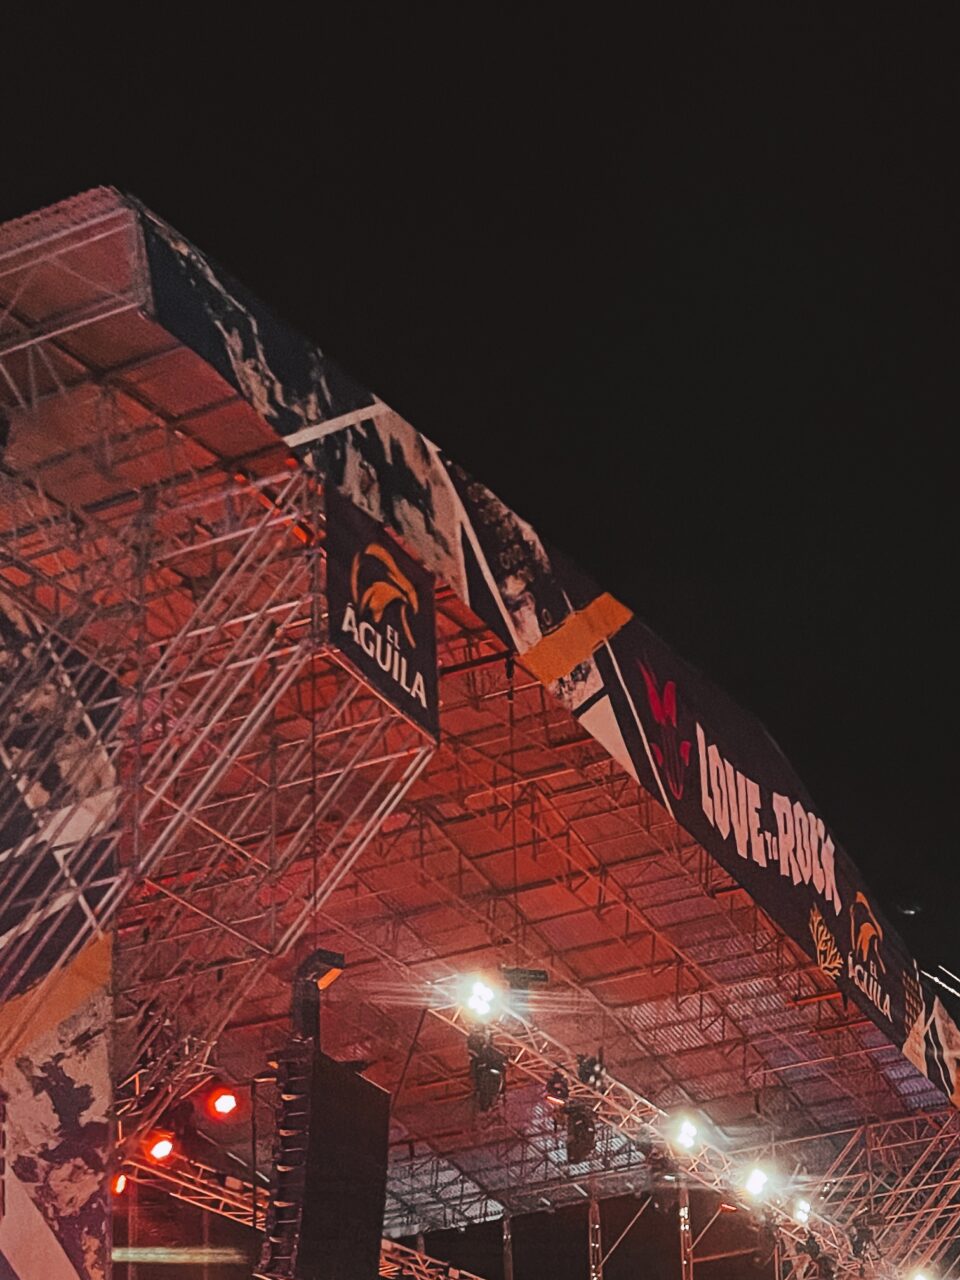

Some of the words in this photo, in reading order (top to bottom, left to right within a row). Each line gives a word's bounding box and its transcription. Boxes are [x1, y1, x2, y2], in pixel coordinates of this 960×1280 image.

[386, 624, 401, 650] EL
[696, 721, 767, 868] LOVE
[772, 791, 842, 916] ROCK
